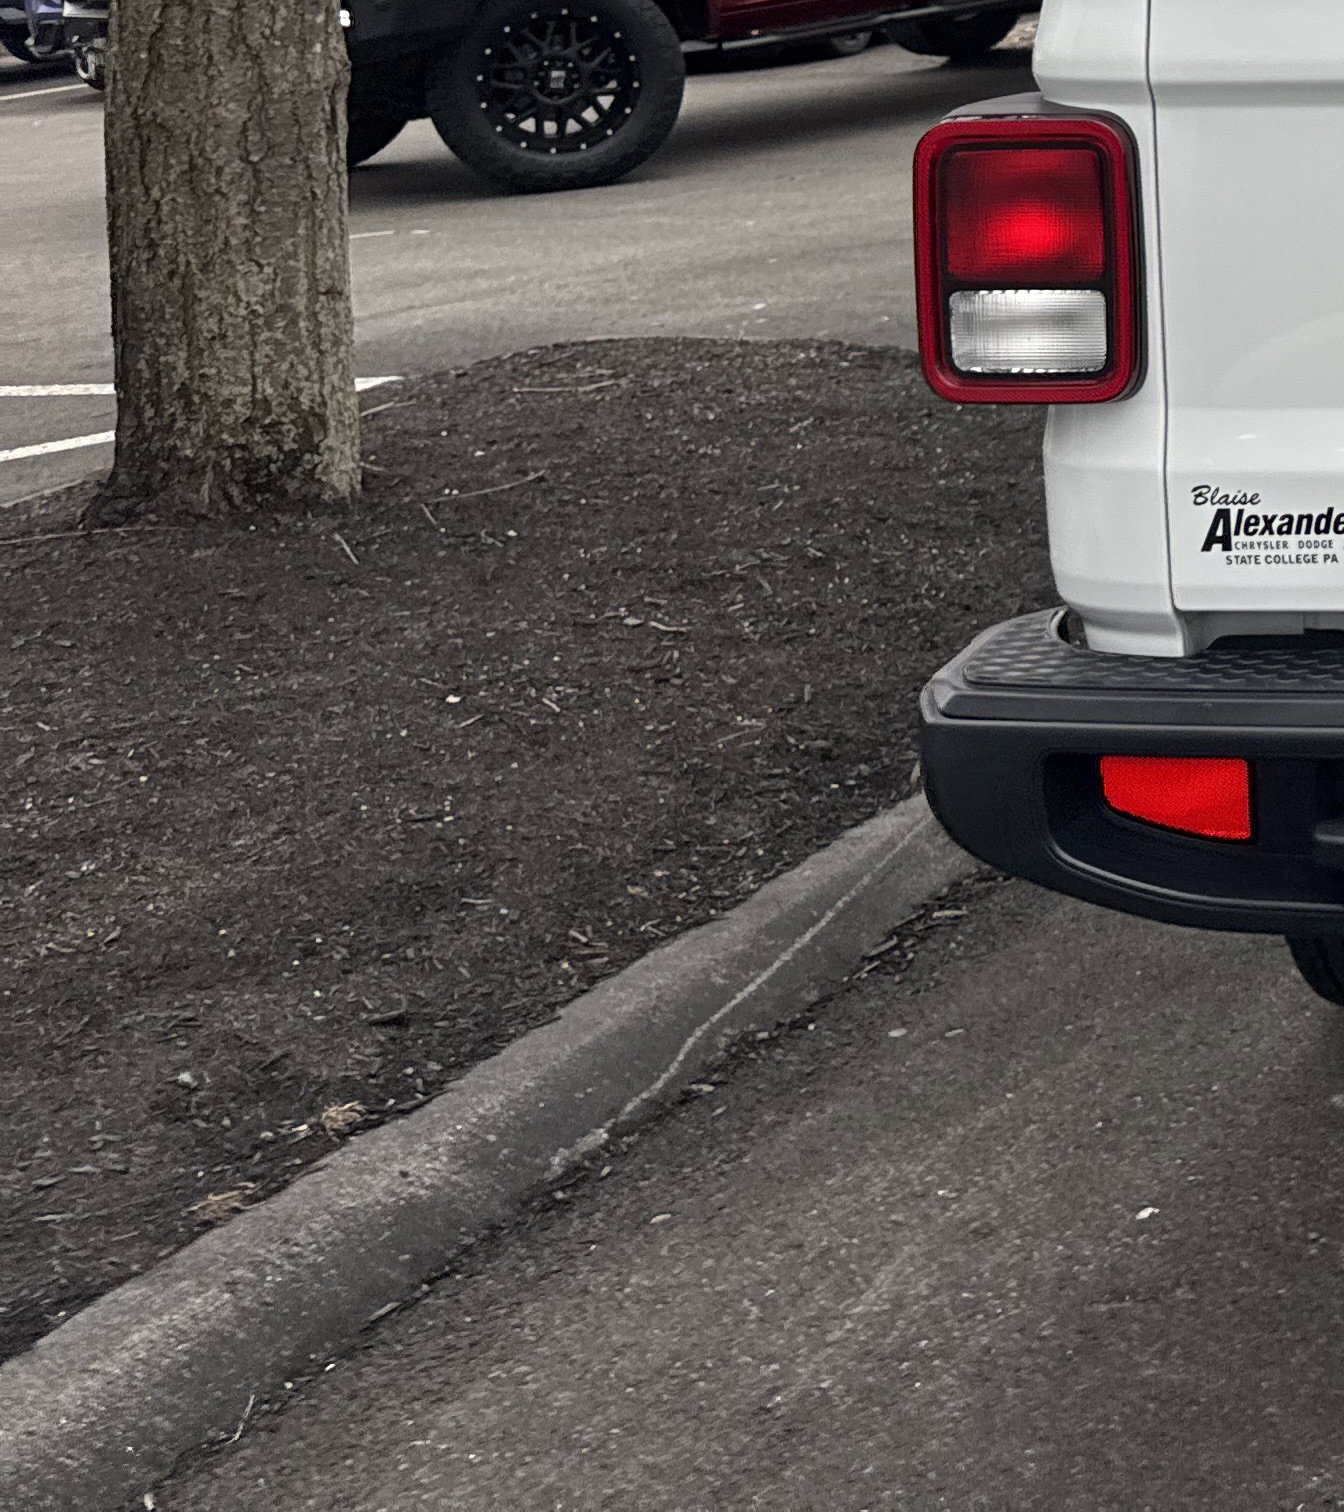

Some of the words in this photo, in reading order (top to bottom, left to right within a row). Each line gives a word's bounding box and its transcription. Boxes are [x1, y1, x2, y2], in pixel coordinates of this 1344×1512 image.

[1191, 484, 1261, 506] Blaise
[1234, 540, 1289, 550] CHRYSLER
[1298, 539, 1333, 549] DODGE
[1225, 555, 1261, 565] STATE
[1265, 554, 1318, 564] COLLEGE
[1323, 553, 1339, 564] PA
